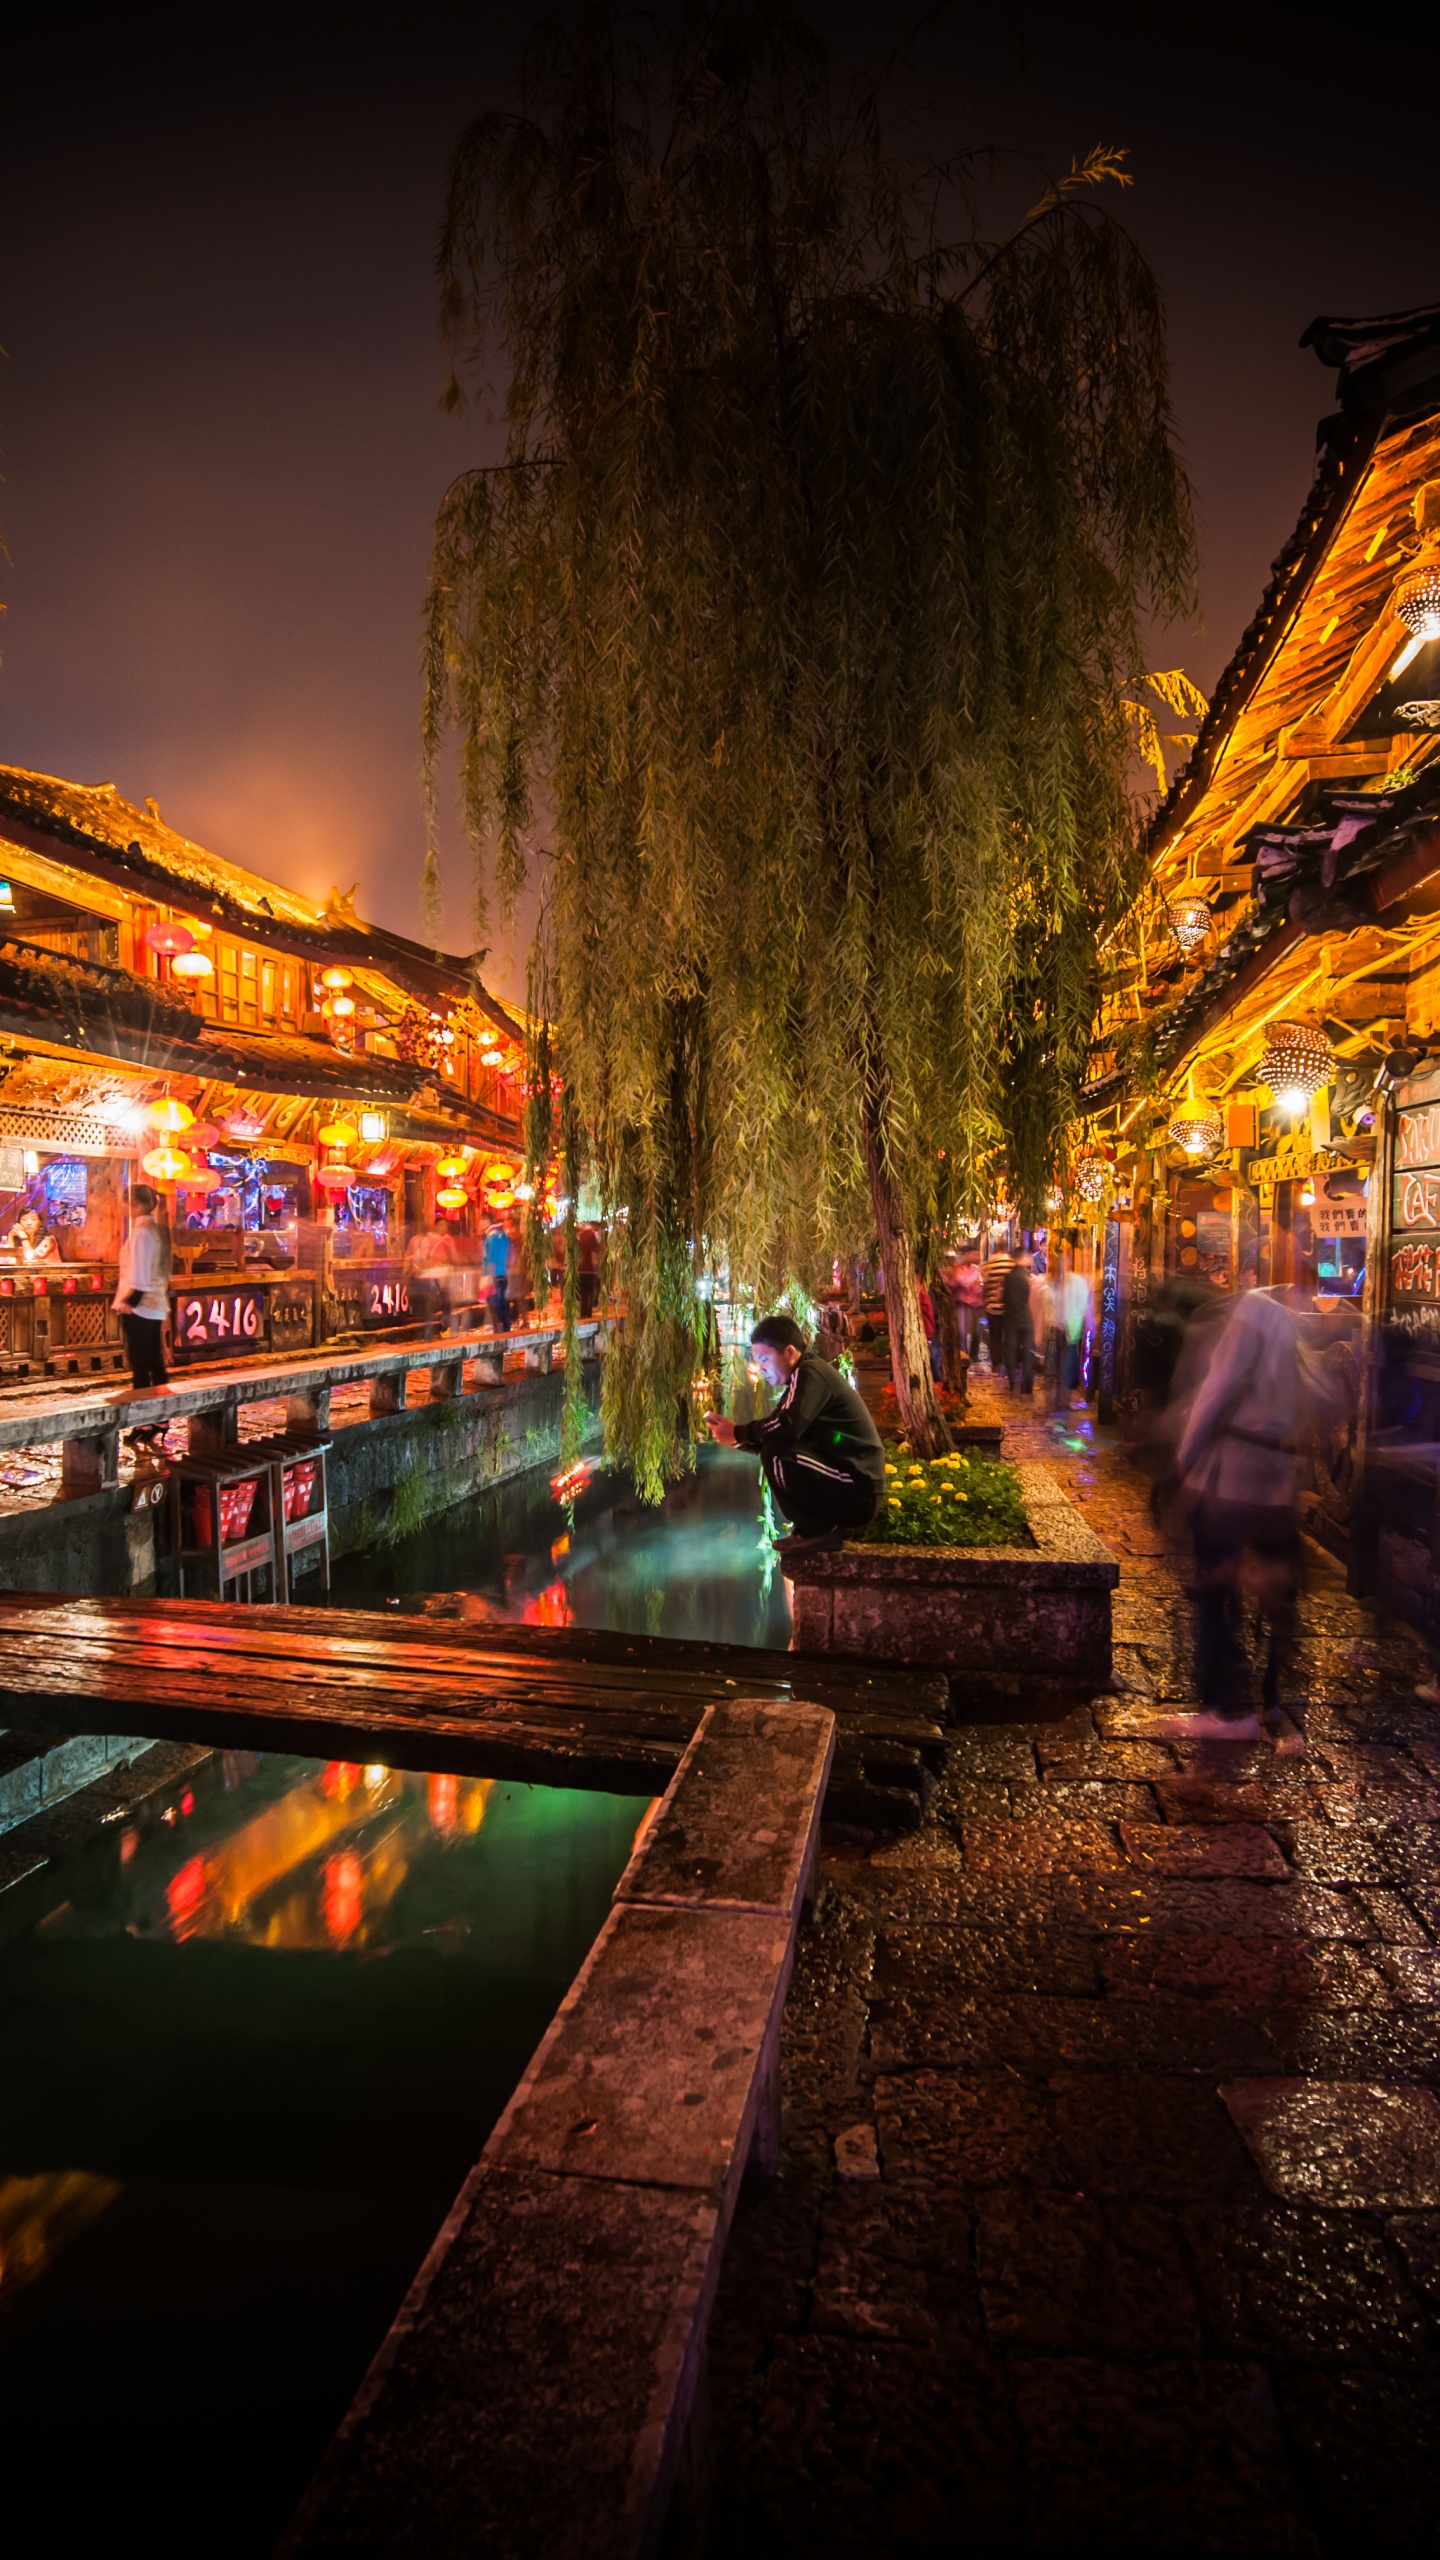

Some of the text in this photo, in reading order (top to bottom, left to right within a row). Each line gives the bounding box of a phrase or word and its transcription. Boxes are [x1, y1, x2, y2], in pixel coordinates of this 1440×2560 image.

[211, 1087, 300, 1128] 2416
[1401, 1172, 1440, 1226] CAF
[1319, 1220, 1367, 1232] 我們賣
[186, 1298, 257, 1340] 2416
[370, 1283, 409, 1314] 2416
